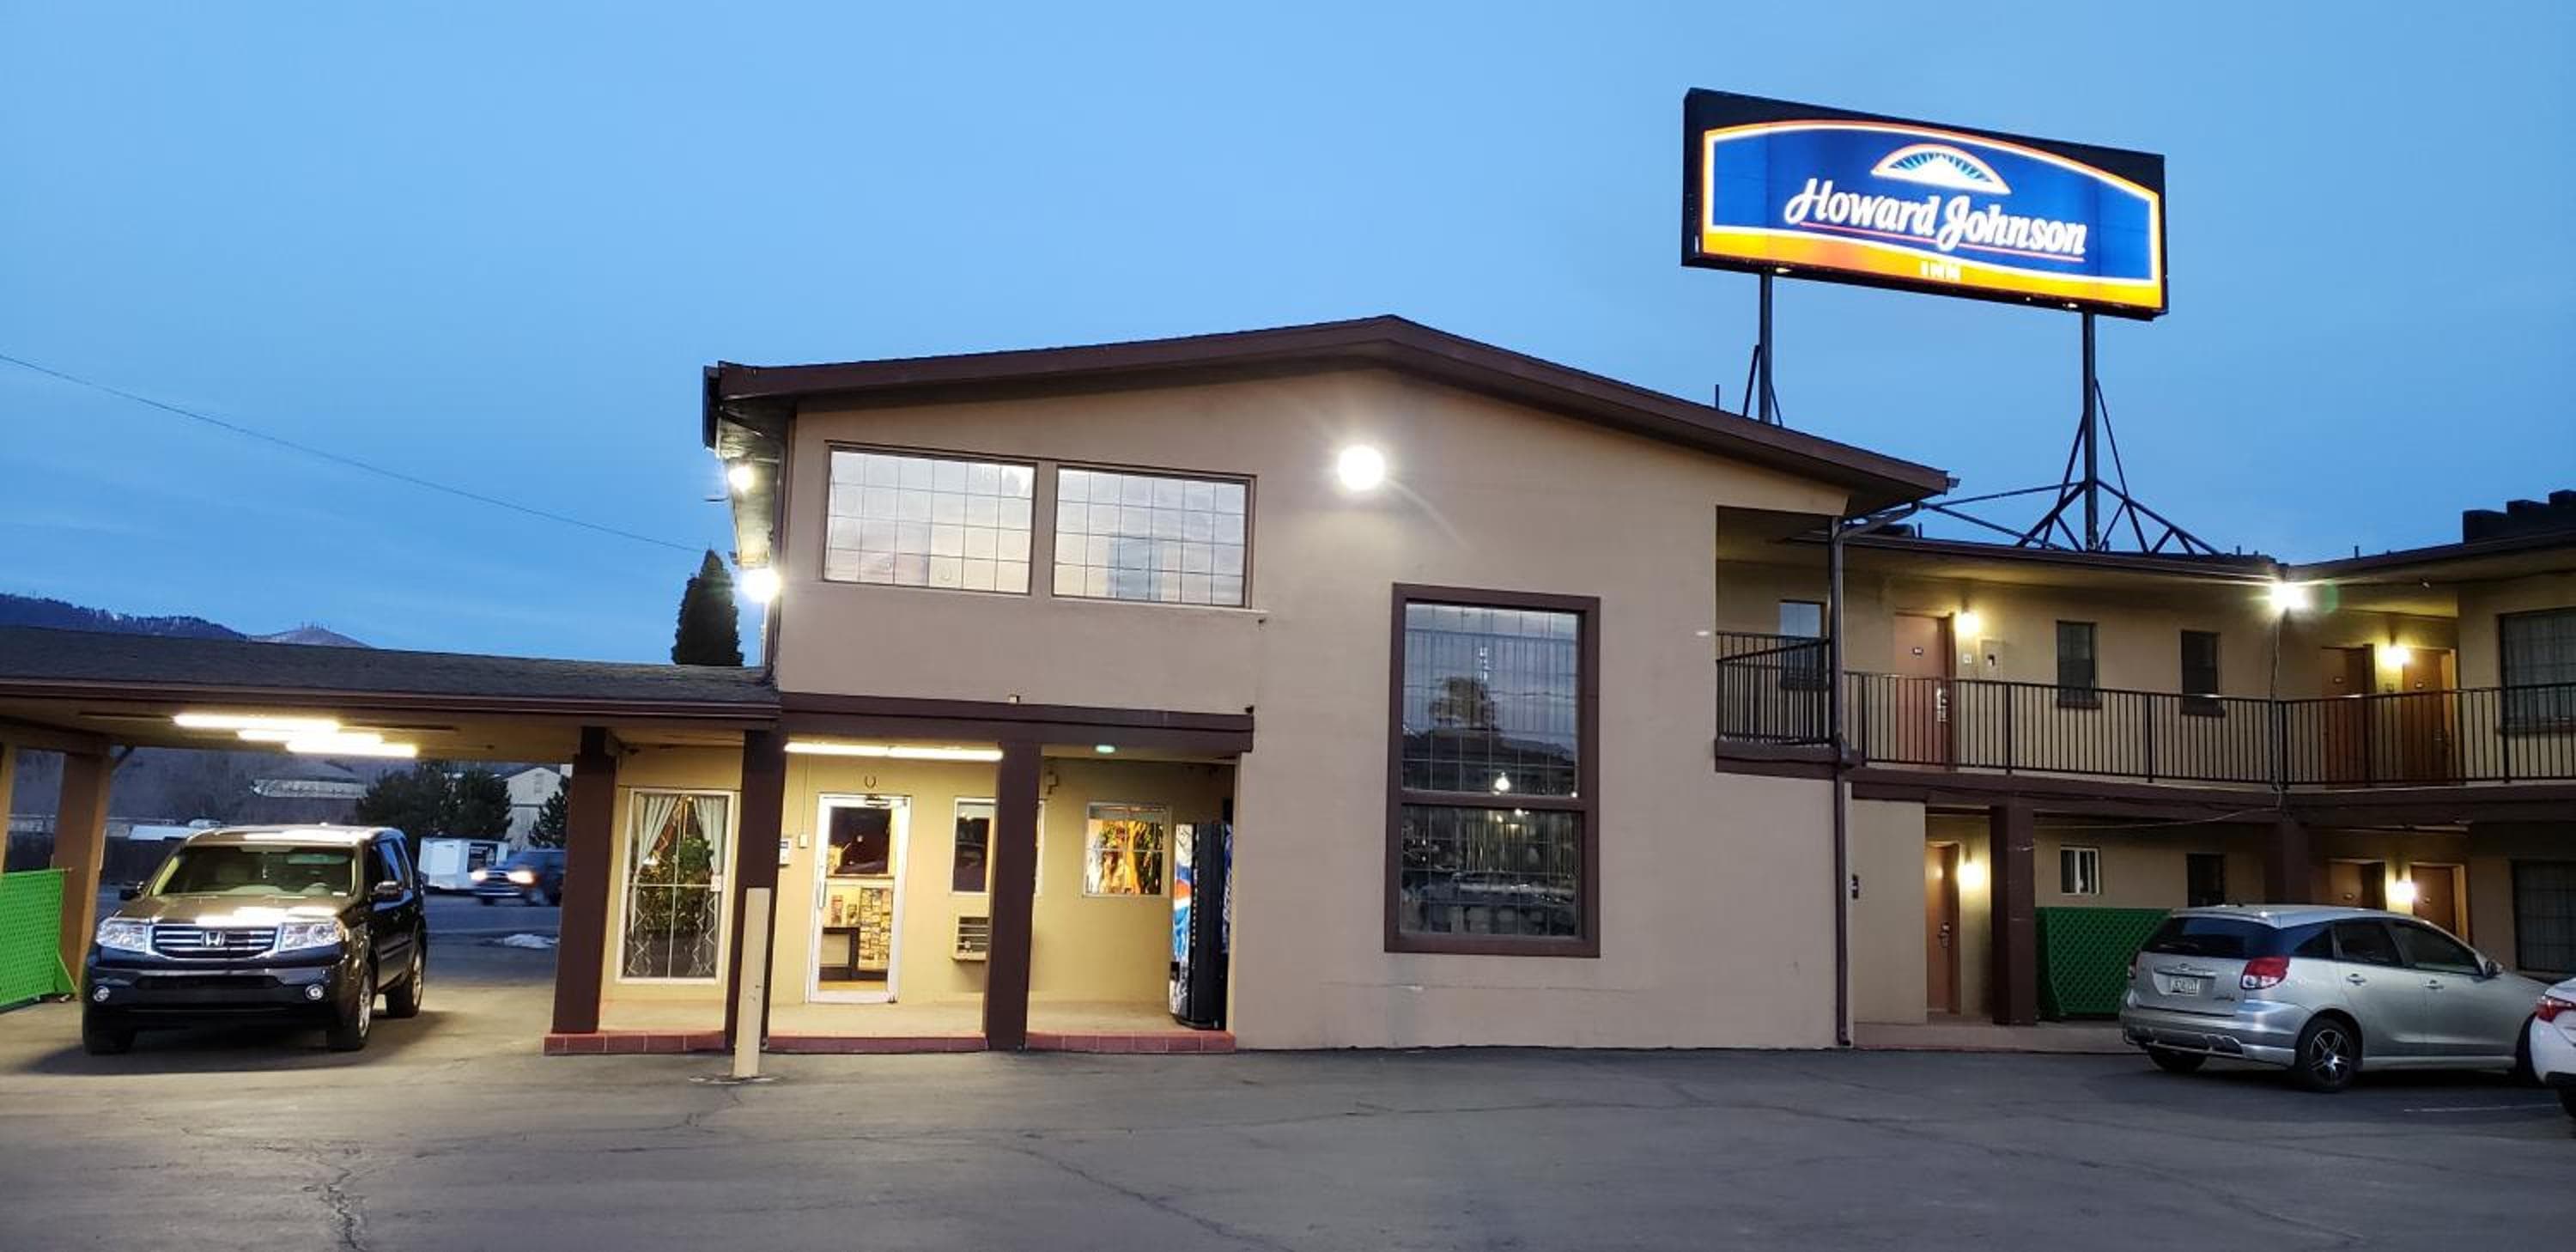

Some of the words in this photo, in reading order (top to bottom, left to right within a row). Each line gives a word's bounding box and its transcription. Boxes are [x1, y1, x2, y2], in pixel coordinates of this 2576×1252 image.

[1784, 178, 1941, 236] Howard
[1936, 195, 2087, 255] Johnson
[1920, 260, 1962, 282] INN
